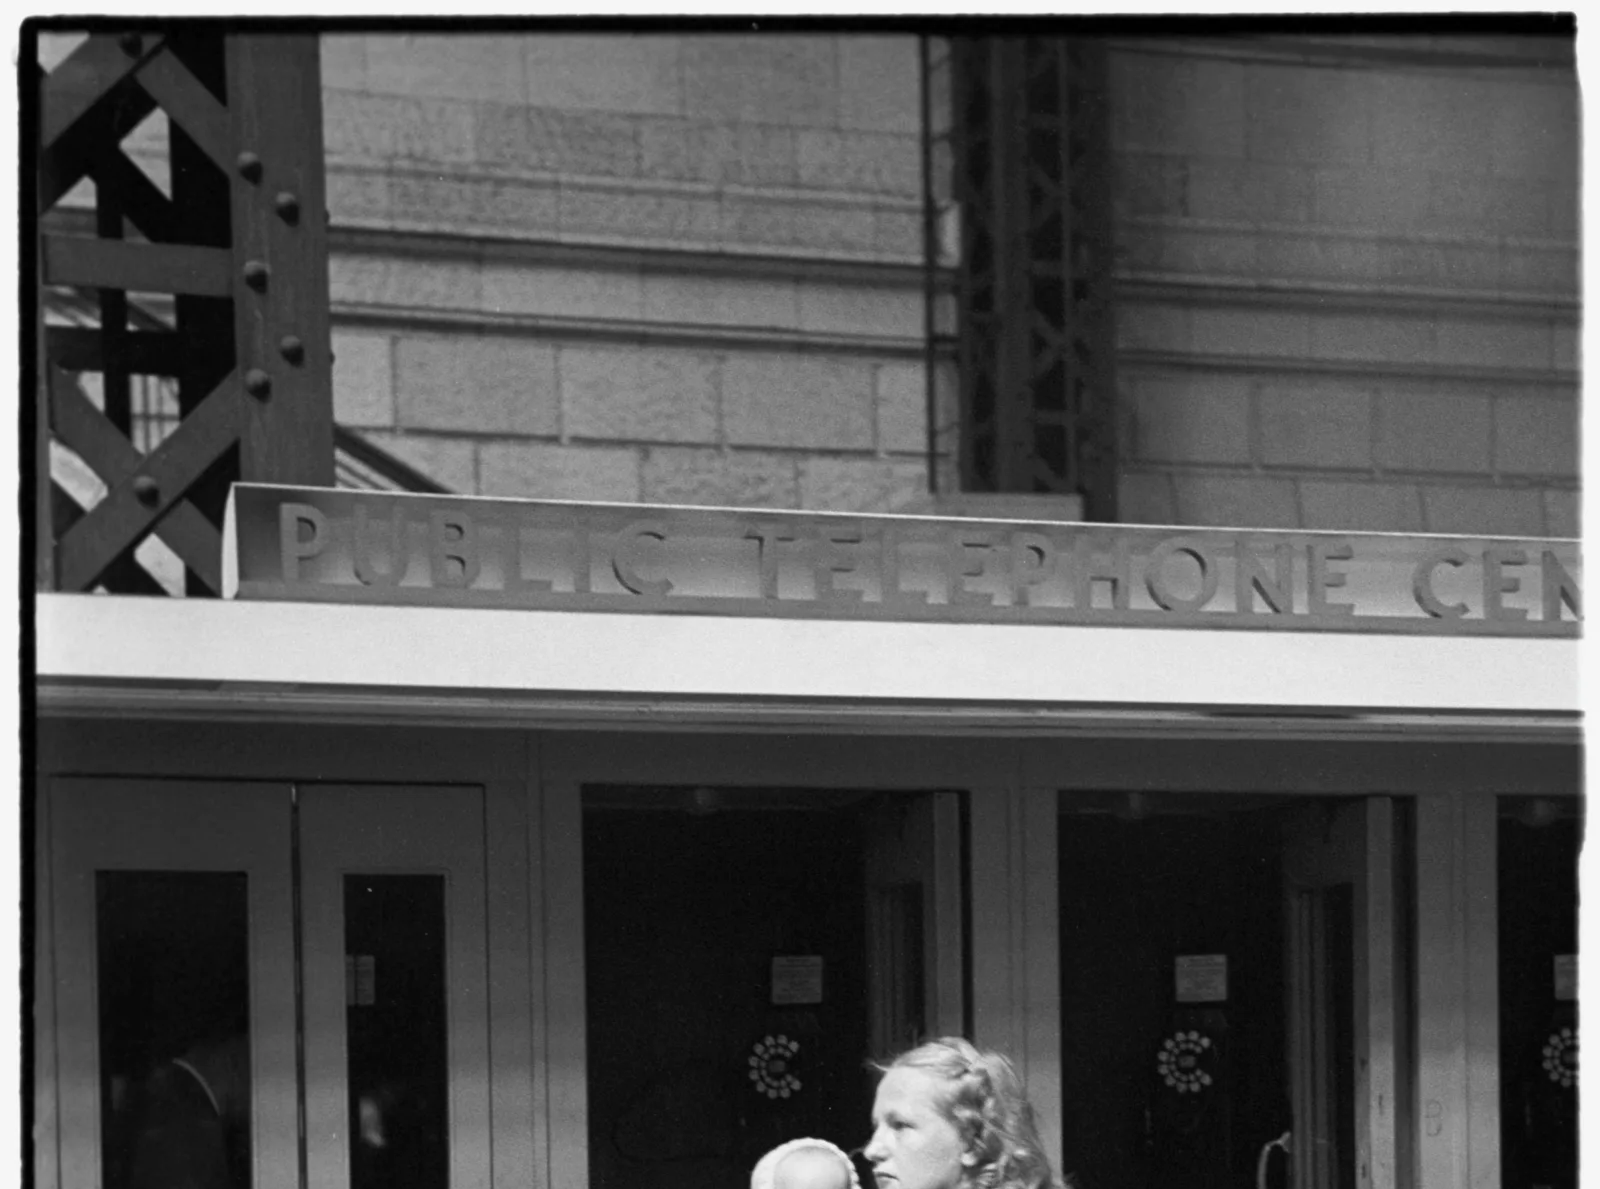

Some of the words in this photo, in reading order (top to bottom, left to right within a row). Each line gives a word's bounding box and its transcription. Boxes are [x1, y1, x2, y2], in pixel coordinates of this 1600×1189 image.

[279, 502, 674, 596] PUBLIC
[743, 524, 1355, 616] TELEPHONE
[1411, 548, 1584, 622] CEN
